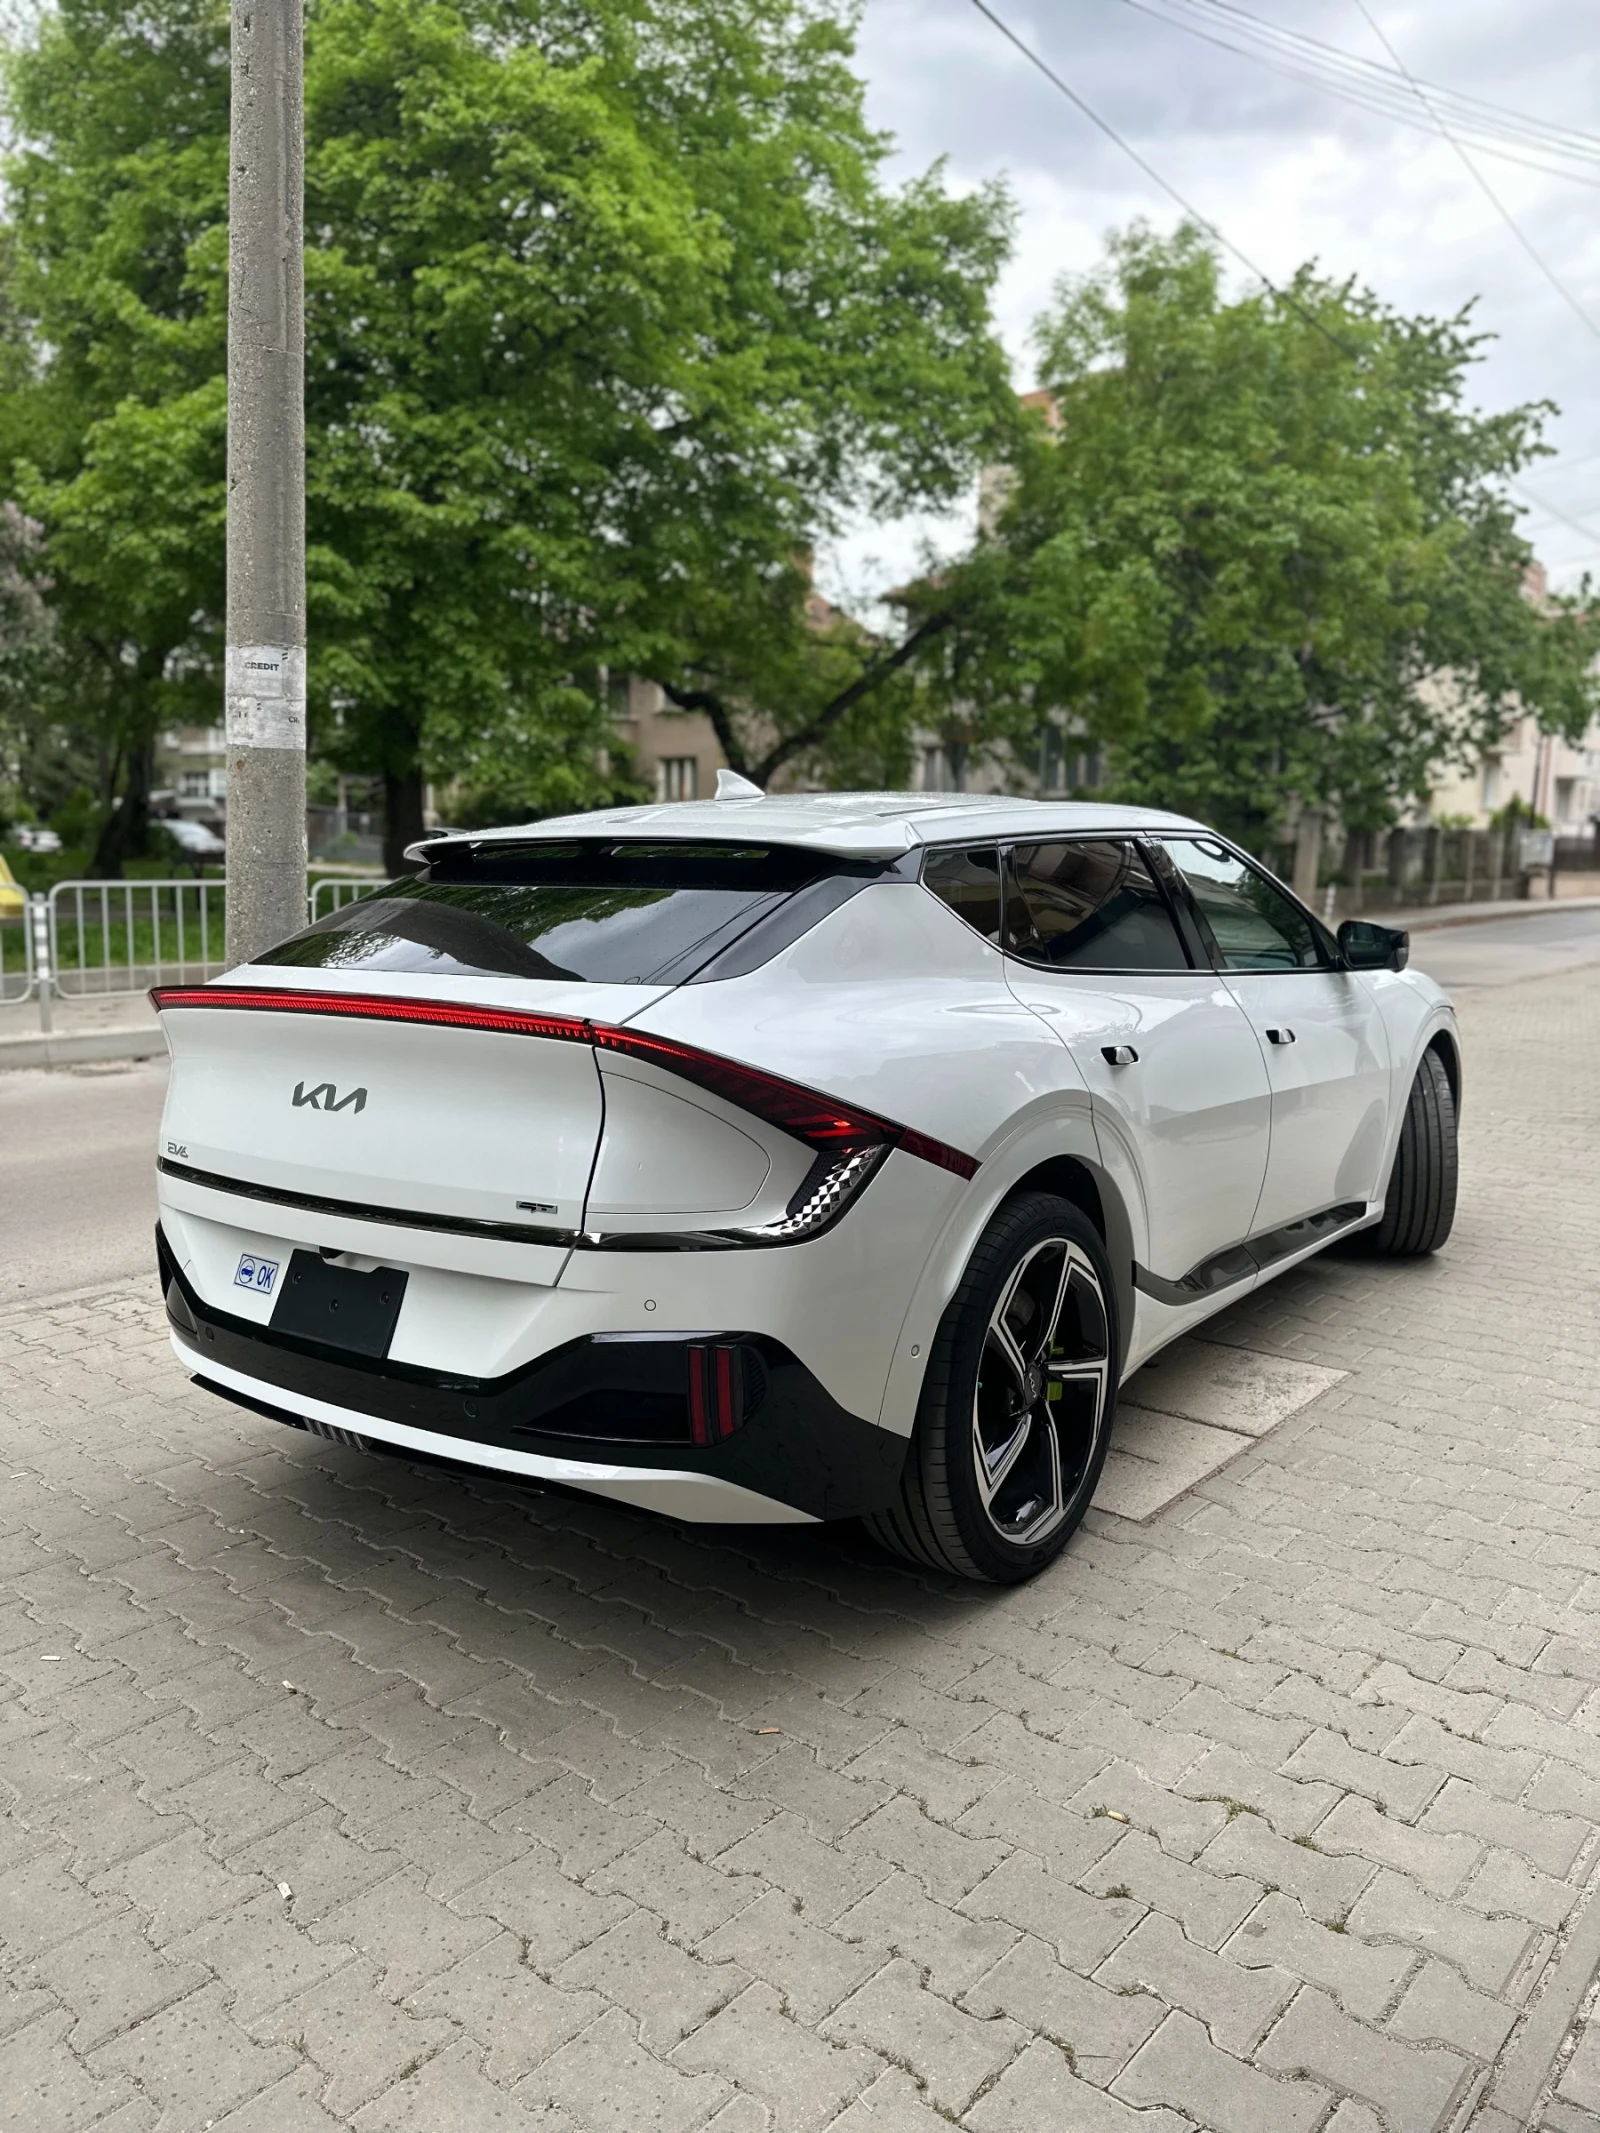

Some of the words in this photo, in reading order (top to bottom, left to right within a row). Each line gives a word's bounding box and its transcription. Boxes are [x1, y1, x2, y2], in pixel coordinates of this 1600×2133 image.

[244, 662, 279, 671] CREDIT
[292, 1081, 367, 1114] KIA
[167, 1141, 189, 1158] EV6
[257, 1265, 275, 1288] OK
